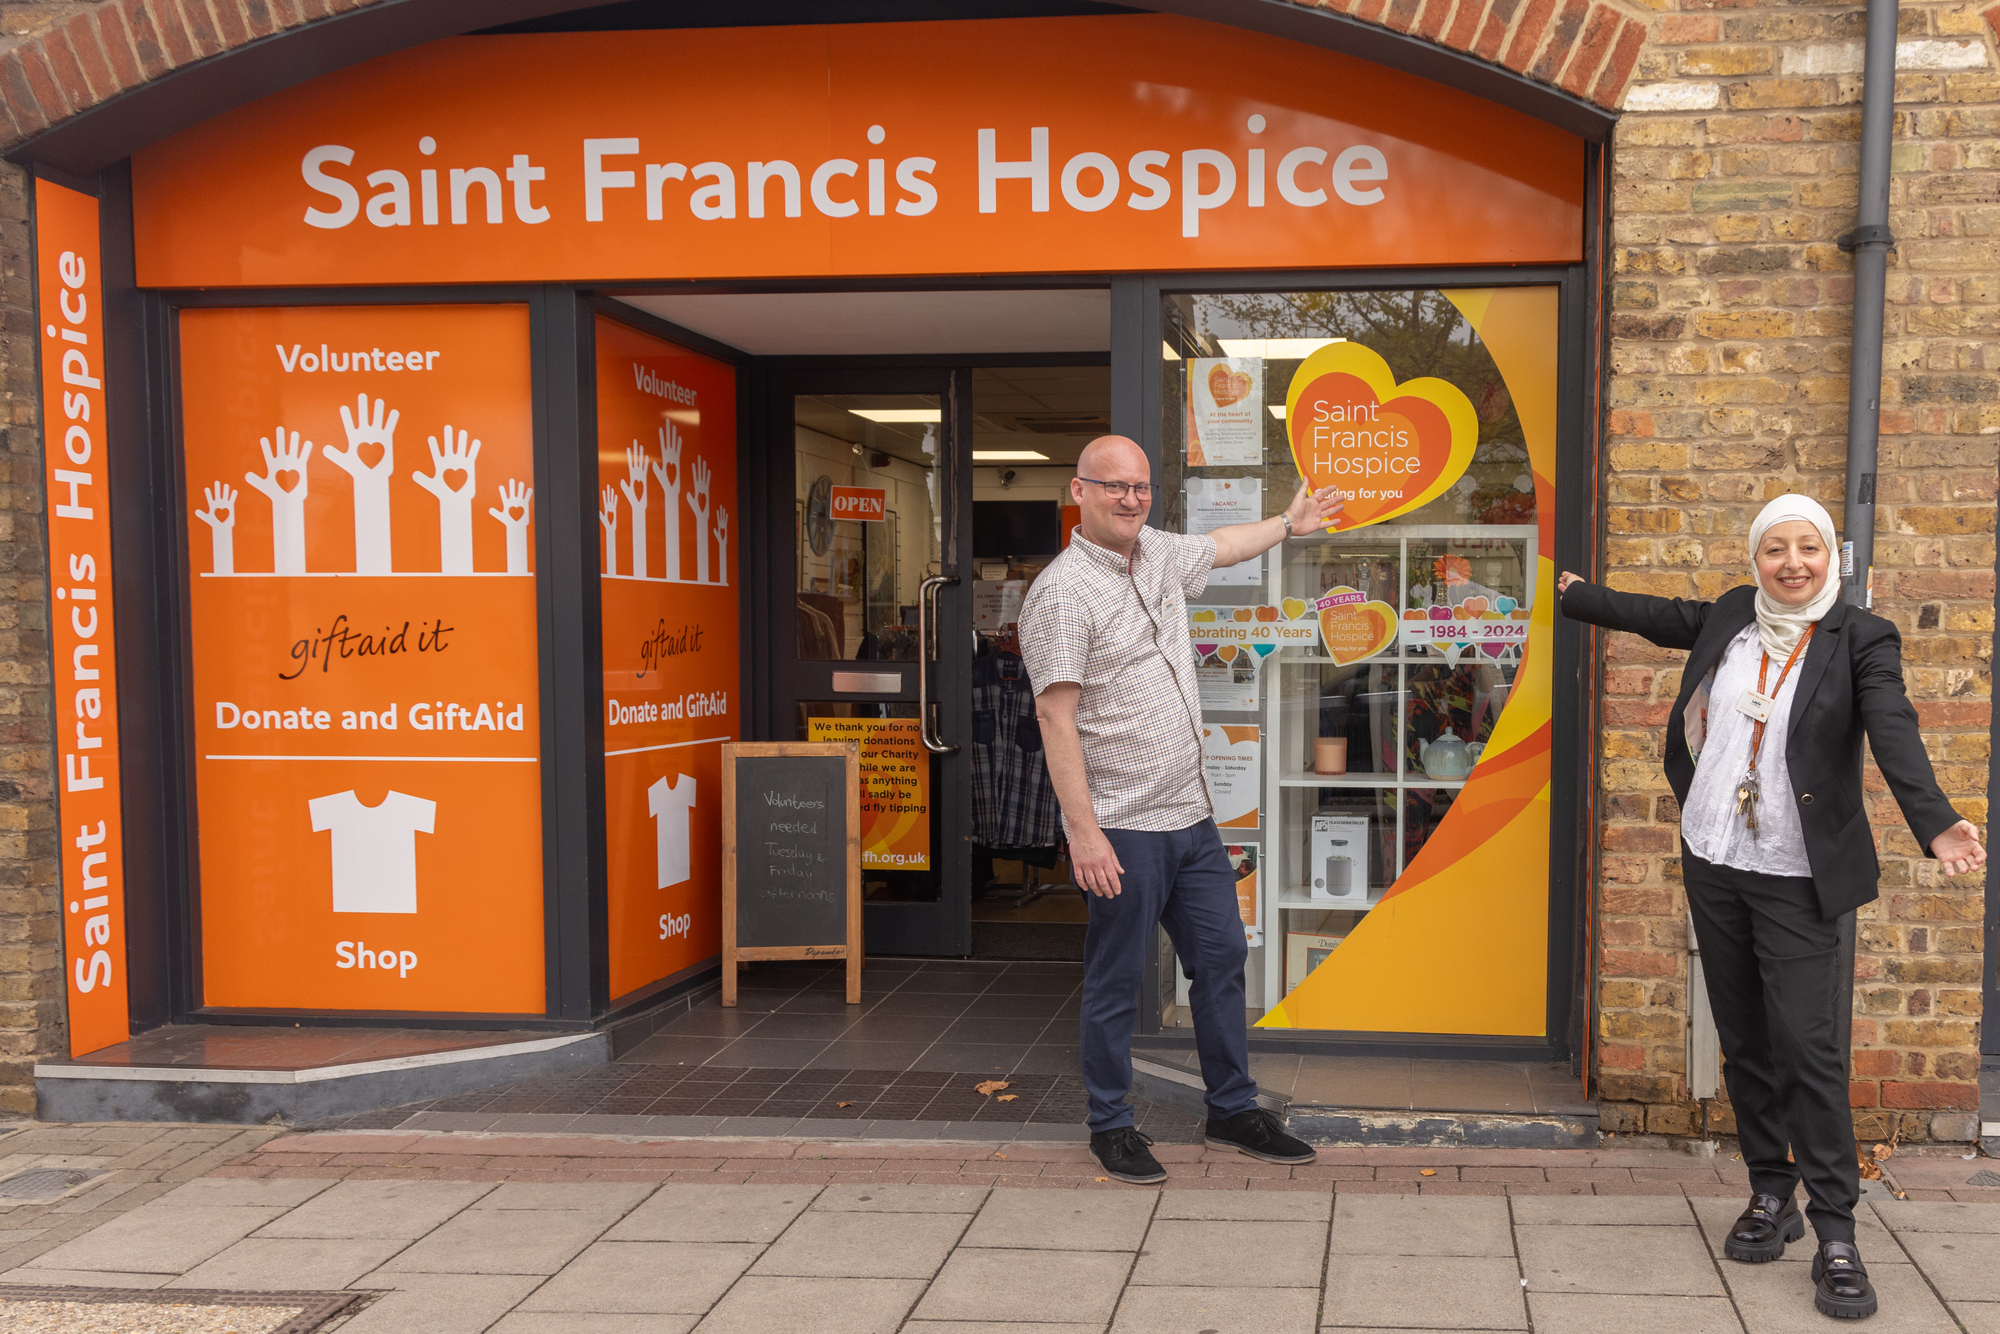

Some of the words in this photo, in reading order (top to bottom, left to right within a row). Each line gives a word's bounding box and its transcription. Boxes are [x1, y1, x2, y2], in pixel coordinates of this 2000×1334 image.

[302, 136, 551, 229] Saint
[583, 124, 938, 222] Francis
[977, 114, 1389, 238] Hospice
[275, 343, 441, 373] Volunteer
[45, 250, 91, 520] Hospice
[633, 362, 698, 407] Volunteer
[1313, 399, 1380, 422] Saint
[1313, 425, 1409, 448] Francis
[1313, 451, 1421, 478] Hospice
[1358, 487, 1377, 499] for
[1379, 489, 1403, 501] you
[833, 496, 882, 514] OPEN
[1319, 600, 1330, 608] 40
[1333, 594, 1362, 604] YEARS
[1330, 610, 1357, 620] Saint
[1330, 620, 1370, 631] Francis
[1188, 626, 1247, 640] ebrating
[1251, 626, 1270, 638] 40
[1274, 626, 1312, 638] Years
[1330, 632, 1375, 642] Hospice
[1429, 625, 1467, 638] 1984
[1483, 625, 1525, 637] 2024
[278, 614, 409, 680] giftaid
[418, 619, 454, 653] it
[636, 618, 687, 679] giftaid
[690, 623, 704, 652] it
[55, 553, 104, 793] Francis
[215, 701, 332, 730] Donate
[341, 702, 398, 731] and
[408, 700, 524, 731] GiftAid
[608, 699, 658, 726] Donate
[660, 695, 683, 721] and
[686, 690, 727, 718] GiftAid
[814, 722, 832, 731] We
[835, 722, 864, 731] thank
[889, 722, 904, 731] for
[863, 736, 915, 746] donations
[881, 749, 919, 760] Charity
[860, 763, 878, 772] hile
[872, 776, 918, 787] anything
[763, 790, 825, 809] Volunteers
[868, 790, 896, 801] sadly
[898, 790, 912, 799] be
[873, 803, 886, 814] fly
[889, 804, 927, 814] tipping
[770, 820, 817, 834] needed
[764, 842, 813, 866] Tuesday
[816, 852, 826, 864] &
[769, 863, 813, 886] Friday
[69, 819, 112, 994] Saint
[659, 912, 691, 941] Shop
[335, 940, 418, 979] Shop
